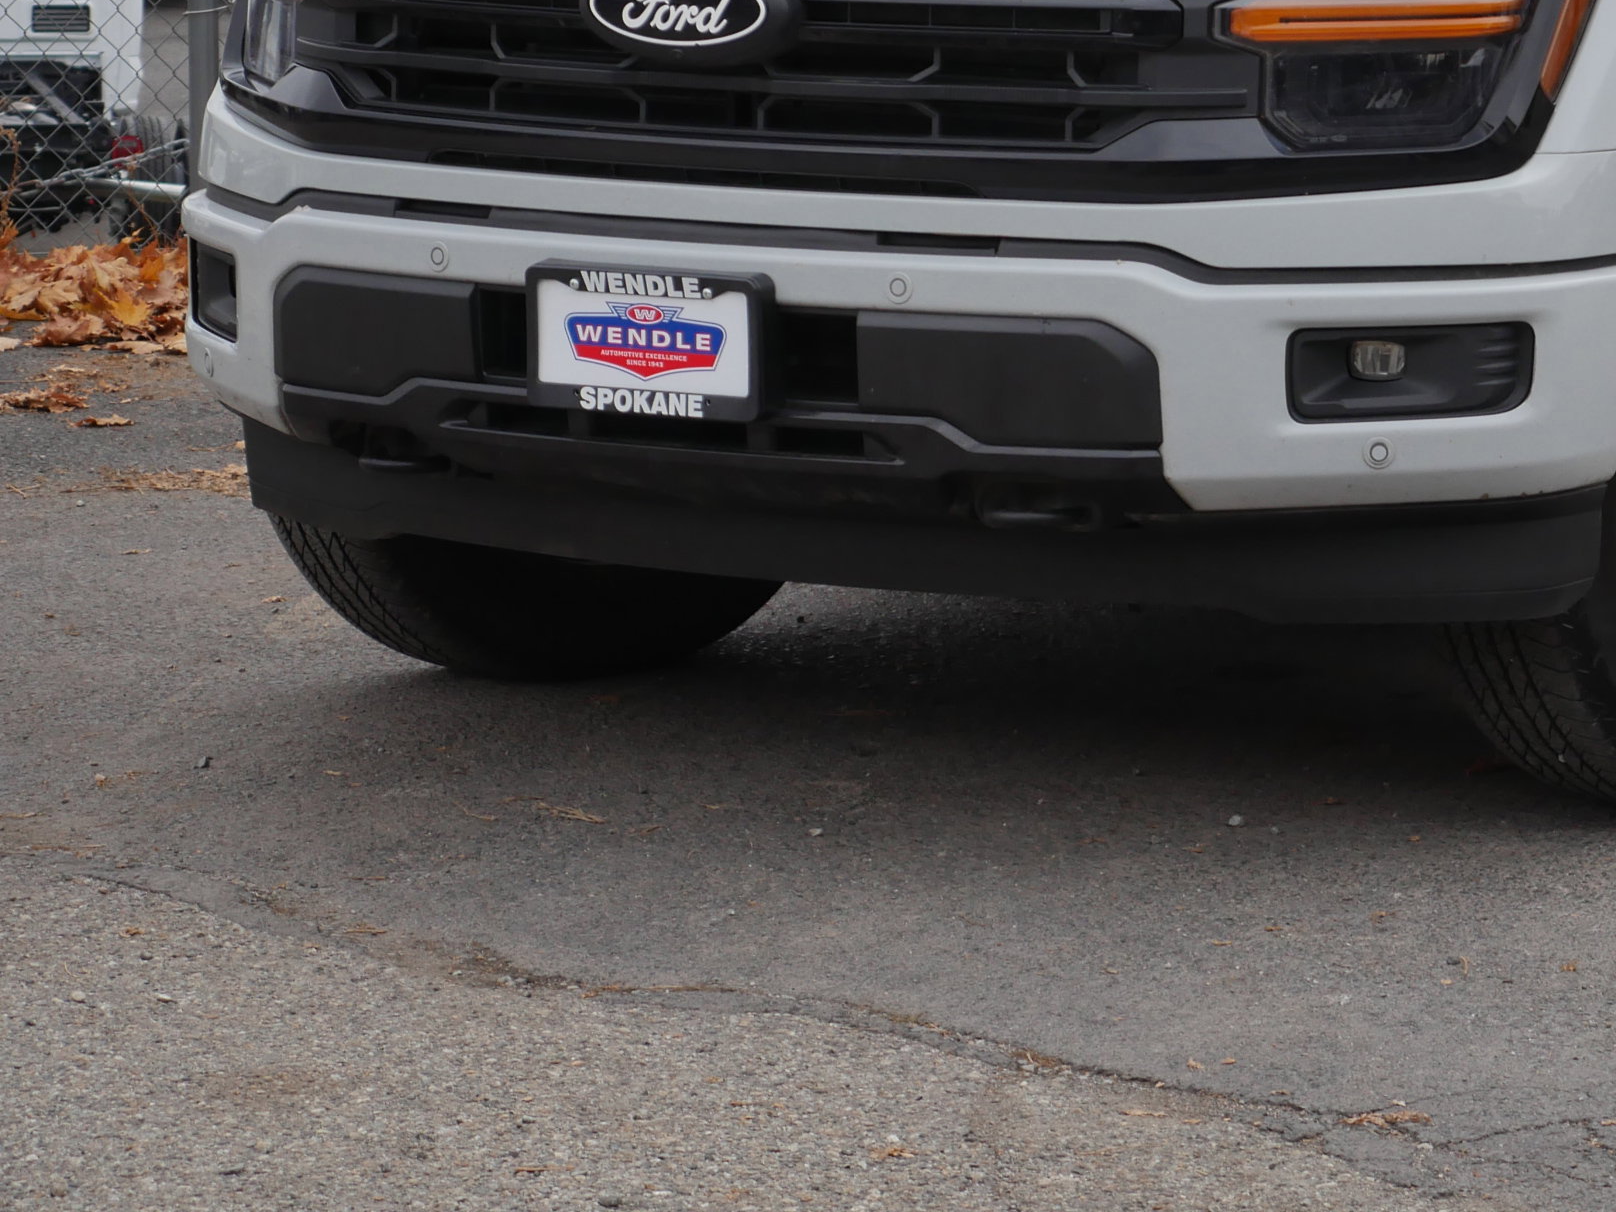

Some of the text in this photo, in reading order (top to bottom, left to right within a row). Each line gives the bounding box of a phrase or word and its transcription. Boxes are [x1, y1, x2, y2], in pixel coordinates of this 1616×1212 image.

[580, 270, 702, 299] WENDLE
[575, 324, 711, 351] WENDLE
[600, 349, 688, 362] AUTOMOTIVE EXCELLENCE
[626, 359, 647, 367] SINCE
[579, 386, 704, 418] SPOKANE
